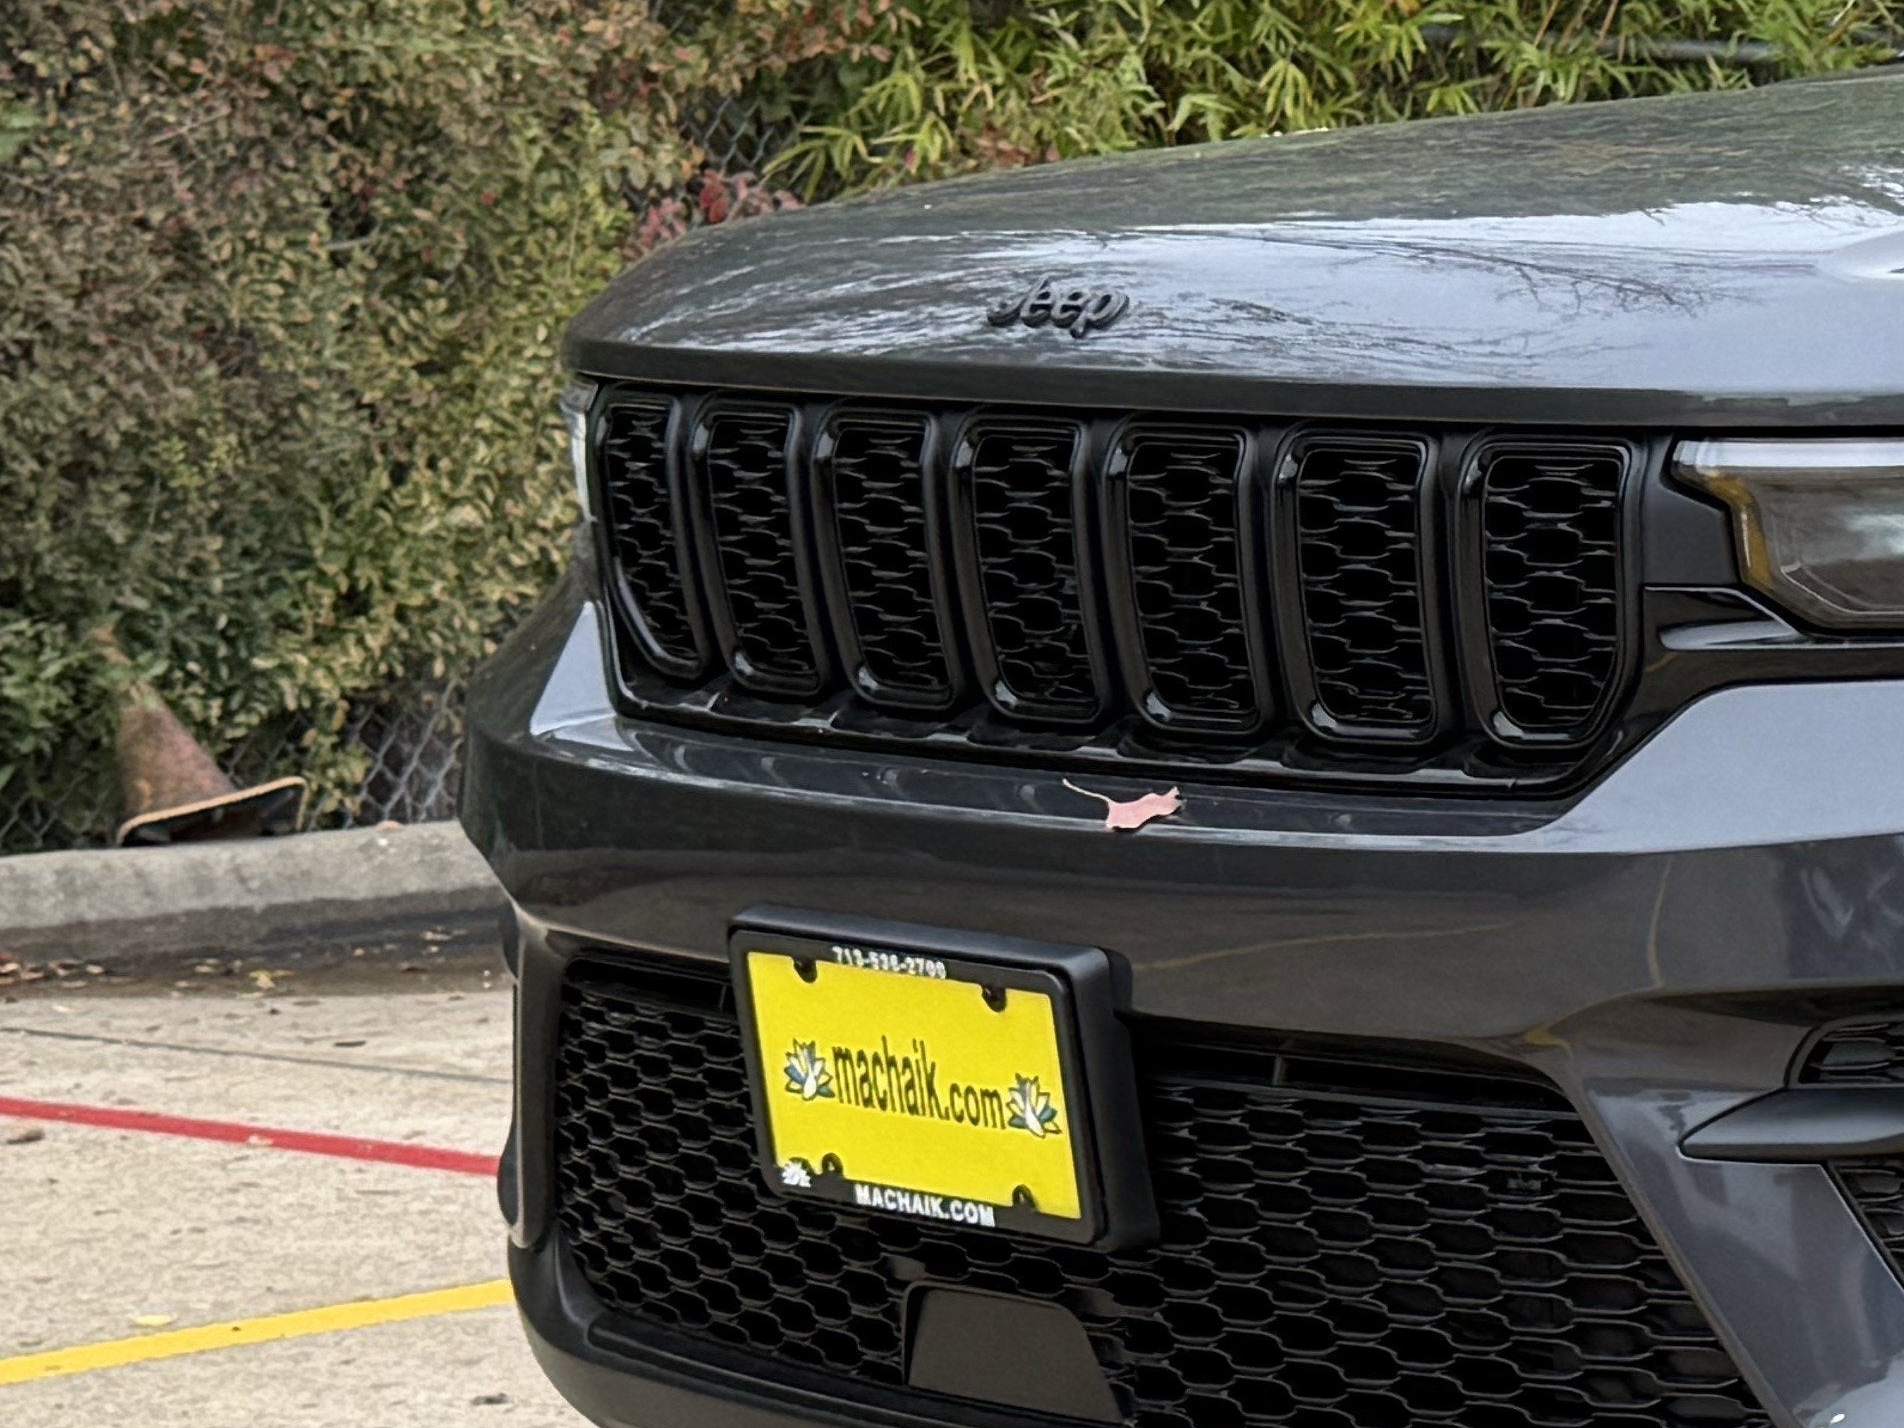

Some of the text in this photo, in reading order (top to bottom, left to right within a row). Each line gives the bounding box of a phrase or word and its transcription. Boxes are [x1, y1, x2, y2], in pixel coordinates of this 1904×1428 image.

[987, 271, 1131, 340] Jeep
[832, 1035, 1006, 1130] machaik.com
[855, 1184, 995, 1228] MACHAIK.COM
